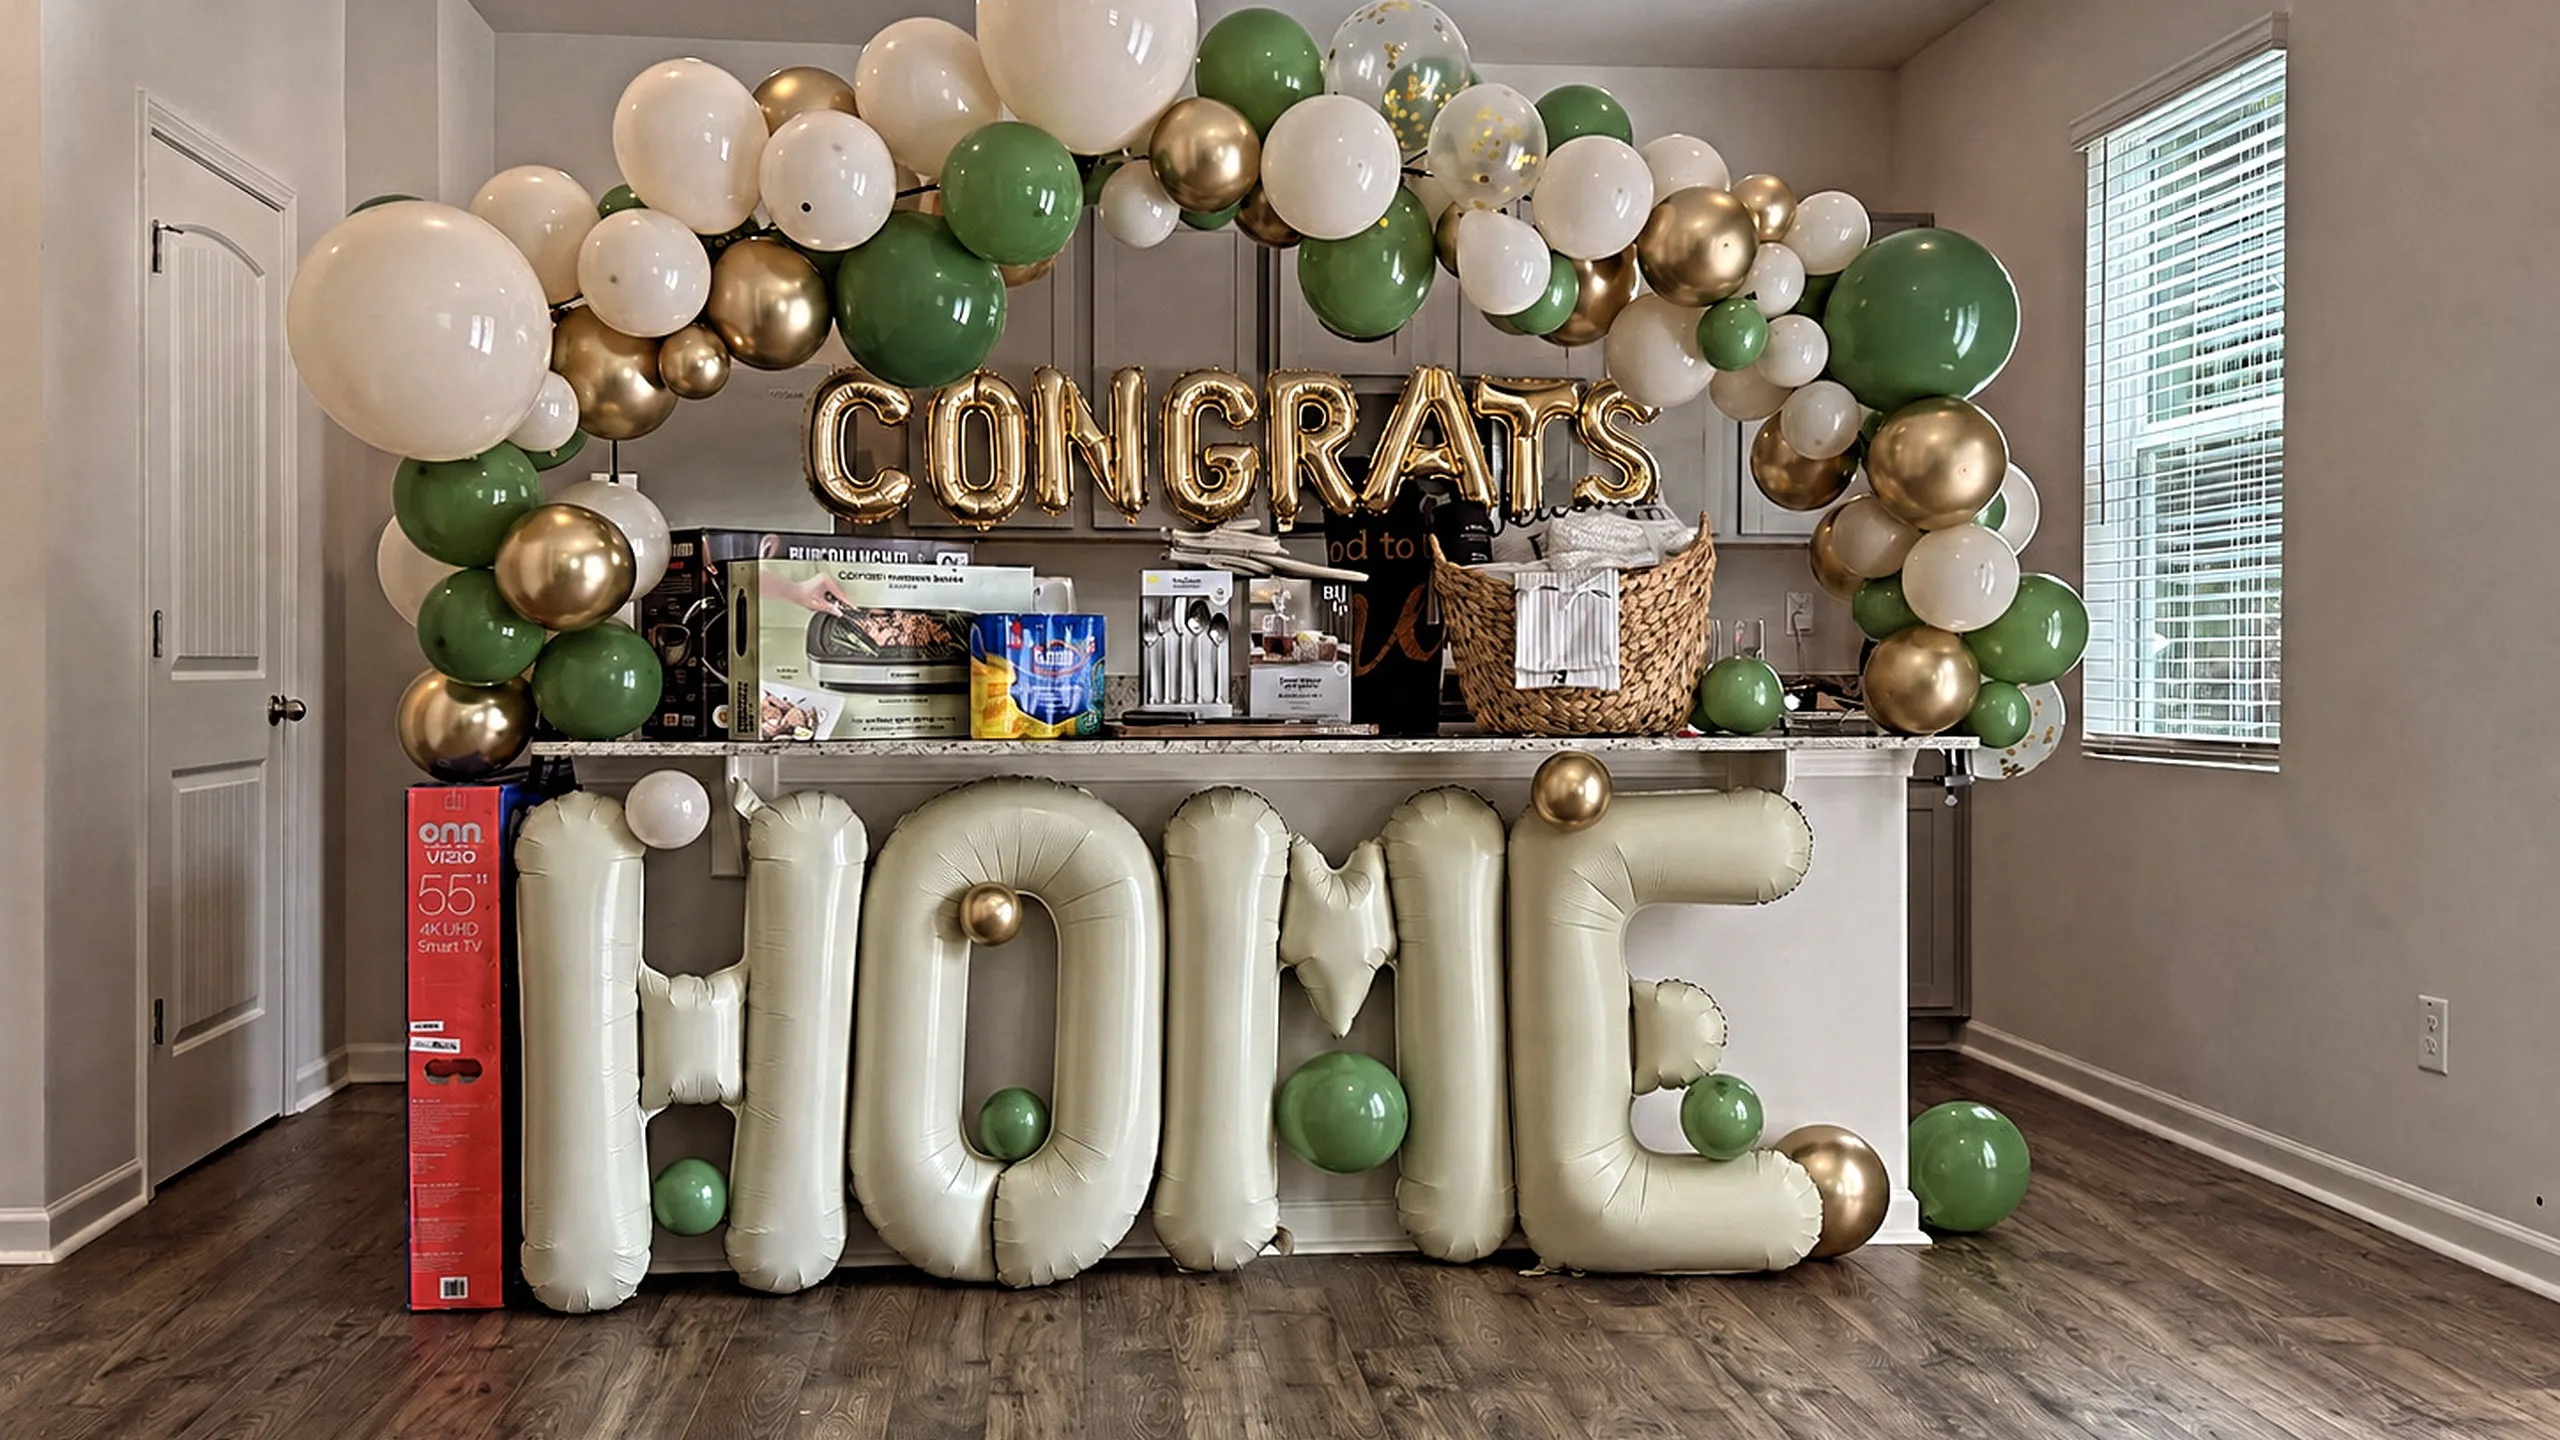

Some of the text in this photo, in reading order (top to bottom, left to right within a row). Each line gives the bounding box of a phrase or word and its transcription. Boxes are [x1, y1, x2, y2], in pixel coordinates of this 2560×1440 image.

[802, 365, 1662, 530] CONGRATS
[1380, 532, 1415, 559] to
[419, 921, 479, 937] 4K UHD
[418, 939, 483, 954] Smart TV
[514, 774, 1824, 1314] HOME
